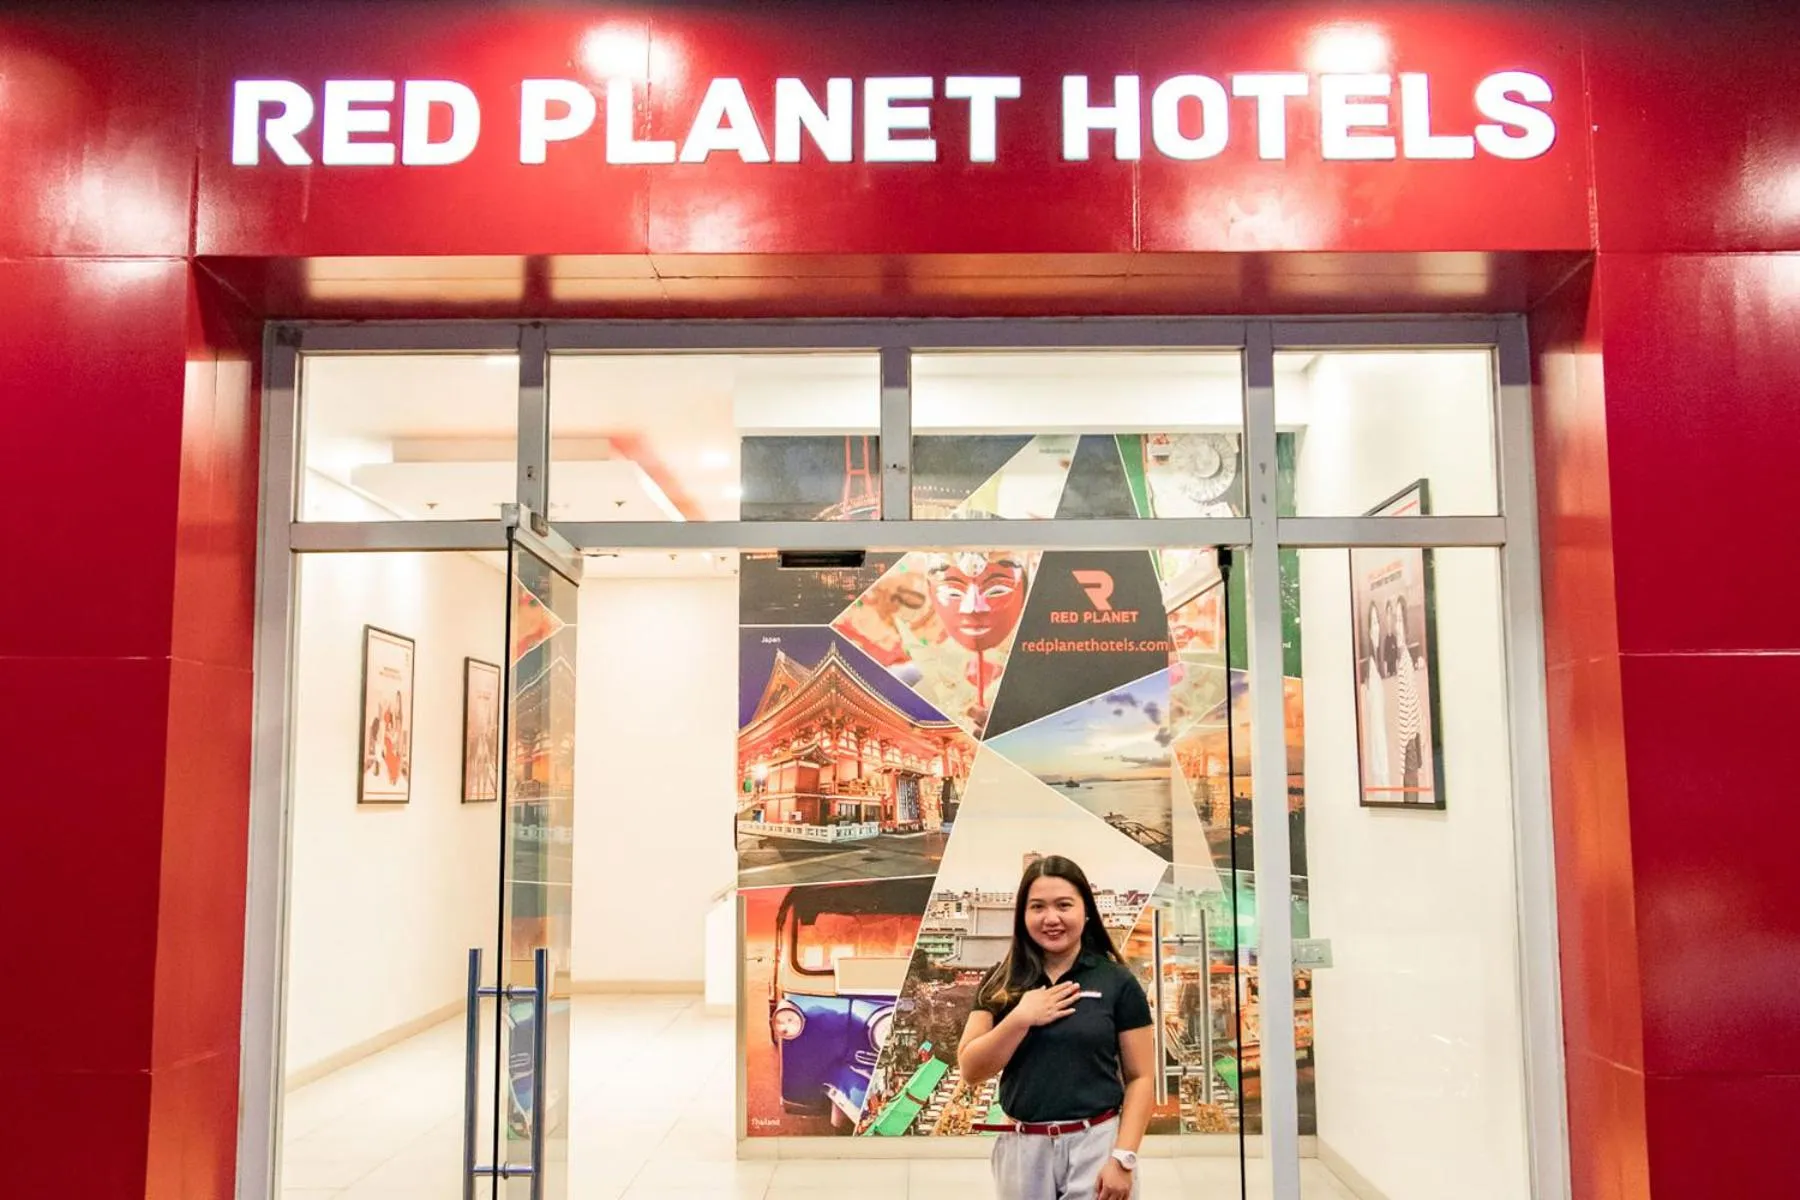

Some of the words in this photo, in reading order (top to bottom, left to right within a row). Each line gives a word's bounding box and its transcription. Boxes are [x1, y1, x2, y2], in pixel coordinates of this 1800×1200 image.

[231, 79, 481, 166] RED
[519, 76, 1021, 165] PLANET
[1061, 70, 1556, 161] HOTELS
[1050, 611, 1079, 623] RED
[1083, 611, 1139, 623] PLANET
[761, 636, 781, 644] Japan
[1021, 638, 1169, 654] redplanethotels.com
